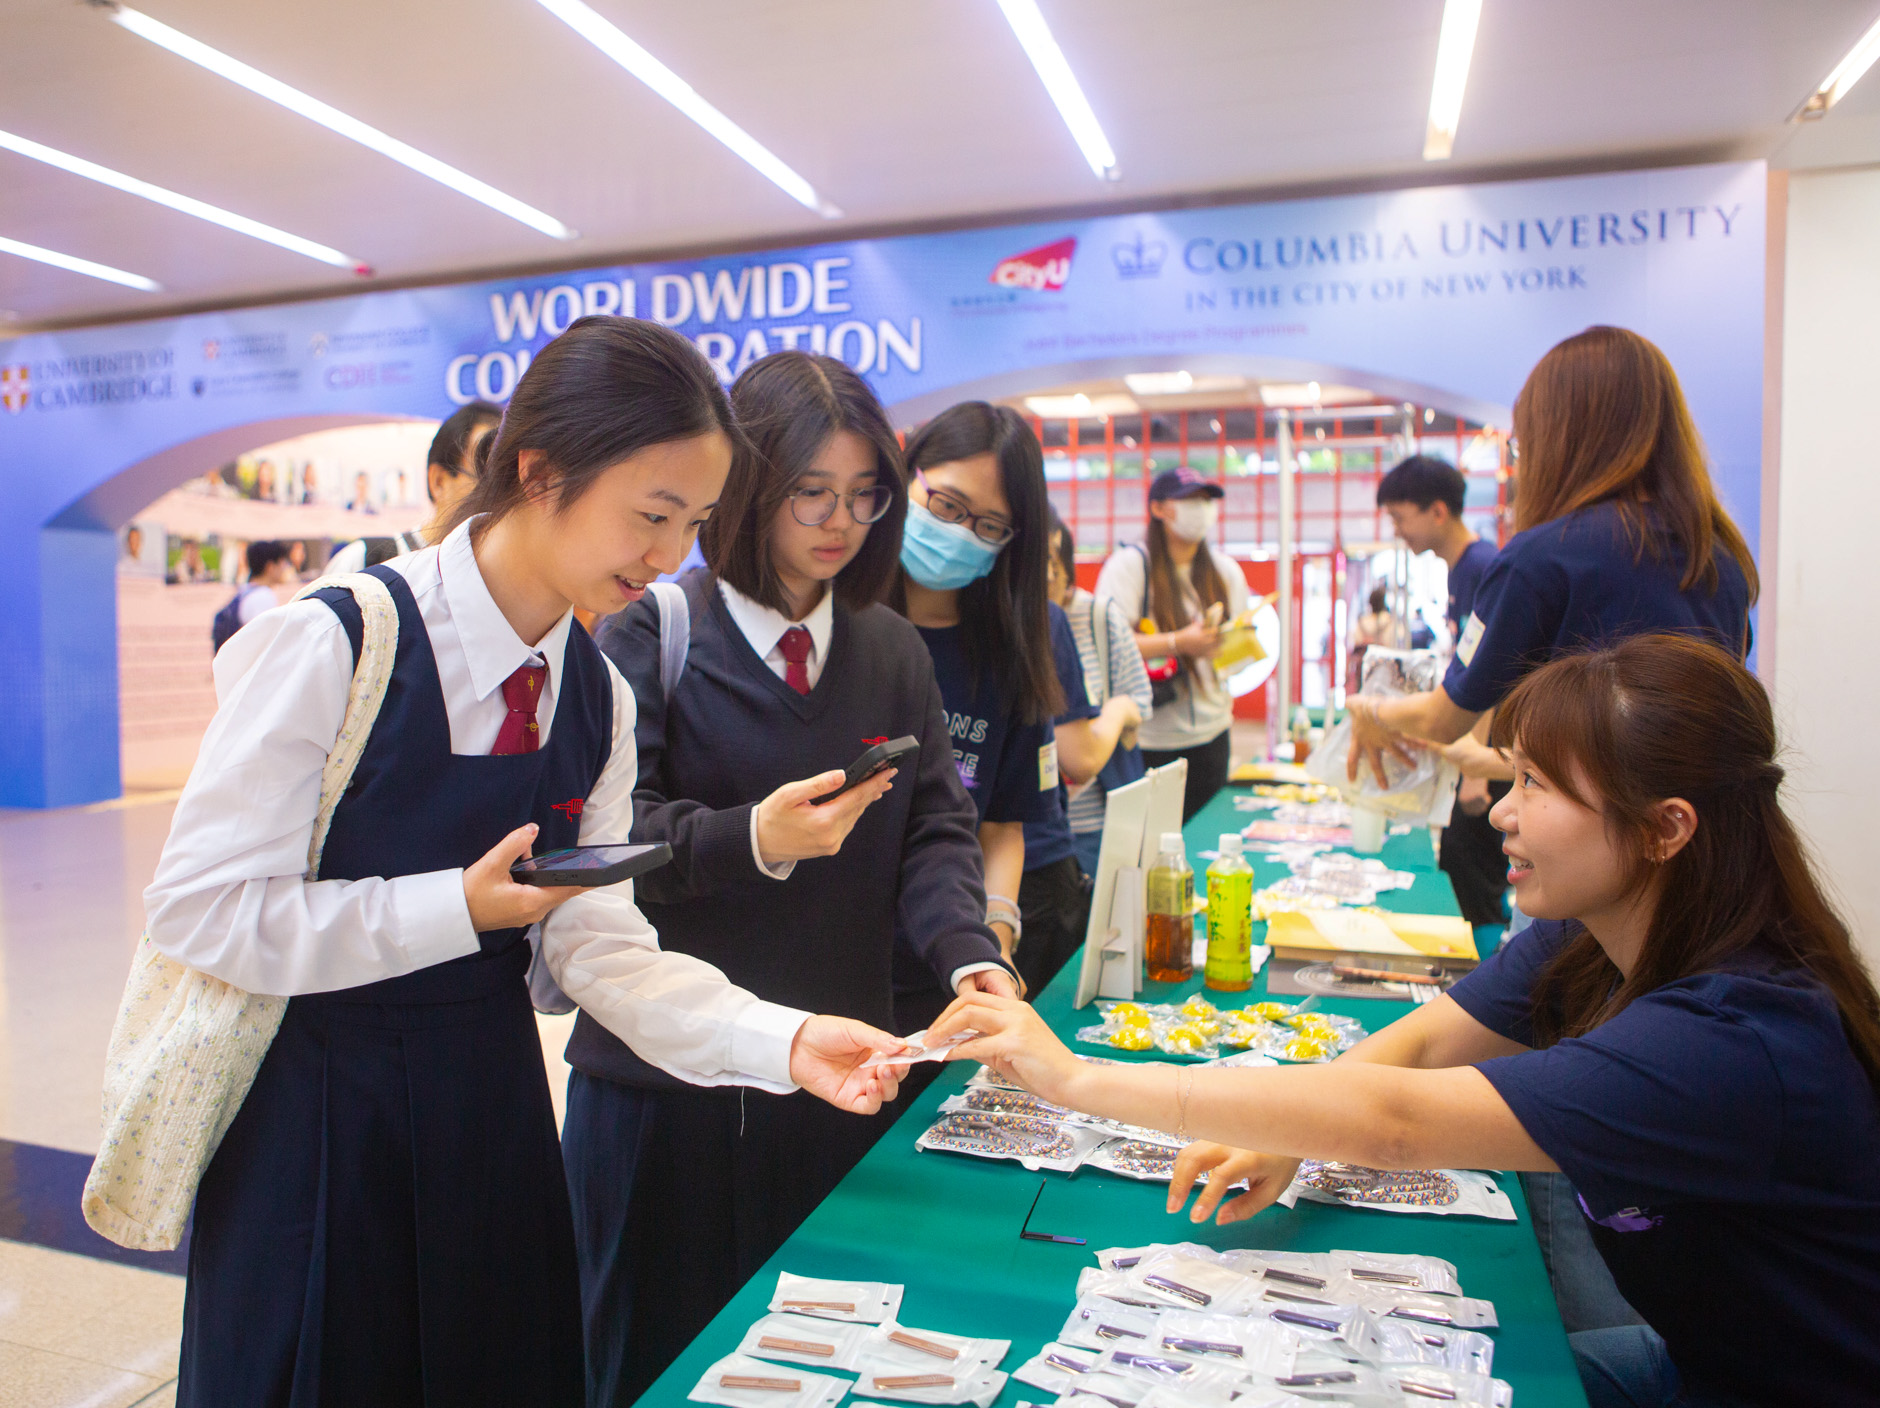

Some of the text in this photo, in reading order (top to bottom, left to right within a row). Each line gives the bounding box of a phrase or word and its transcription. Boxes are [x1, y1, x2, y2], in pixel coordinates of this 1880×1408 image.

[1183, 204, 1741, 276] COLUMBIA UNIVERSITY
[996, 257, 1070, 291] CityU
[1184, 264, 1588, 312] IN THE CITY OF NEW YORK
